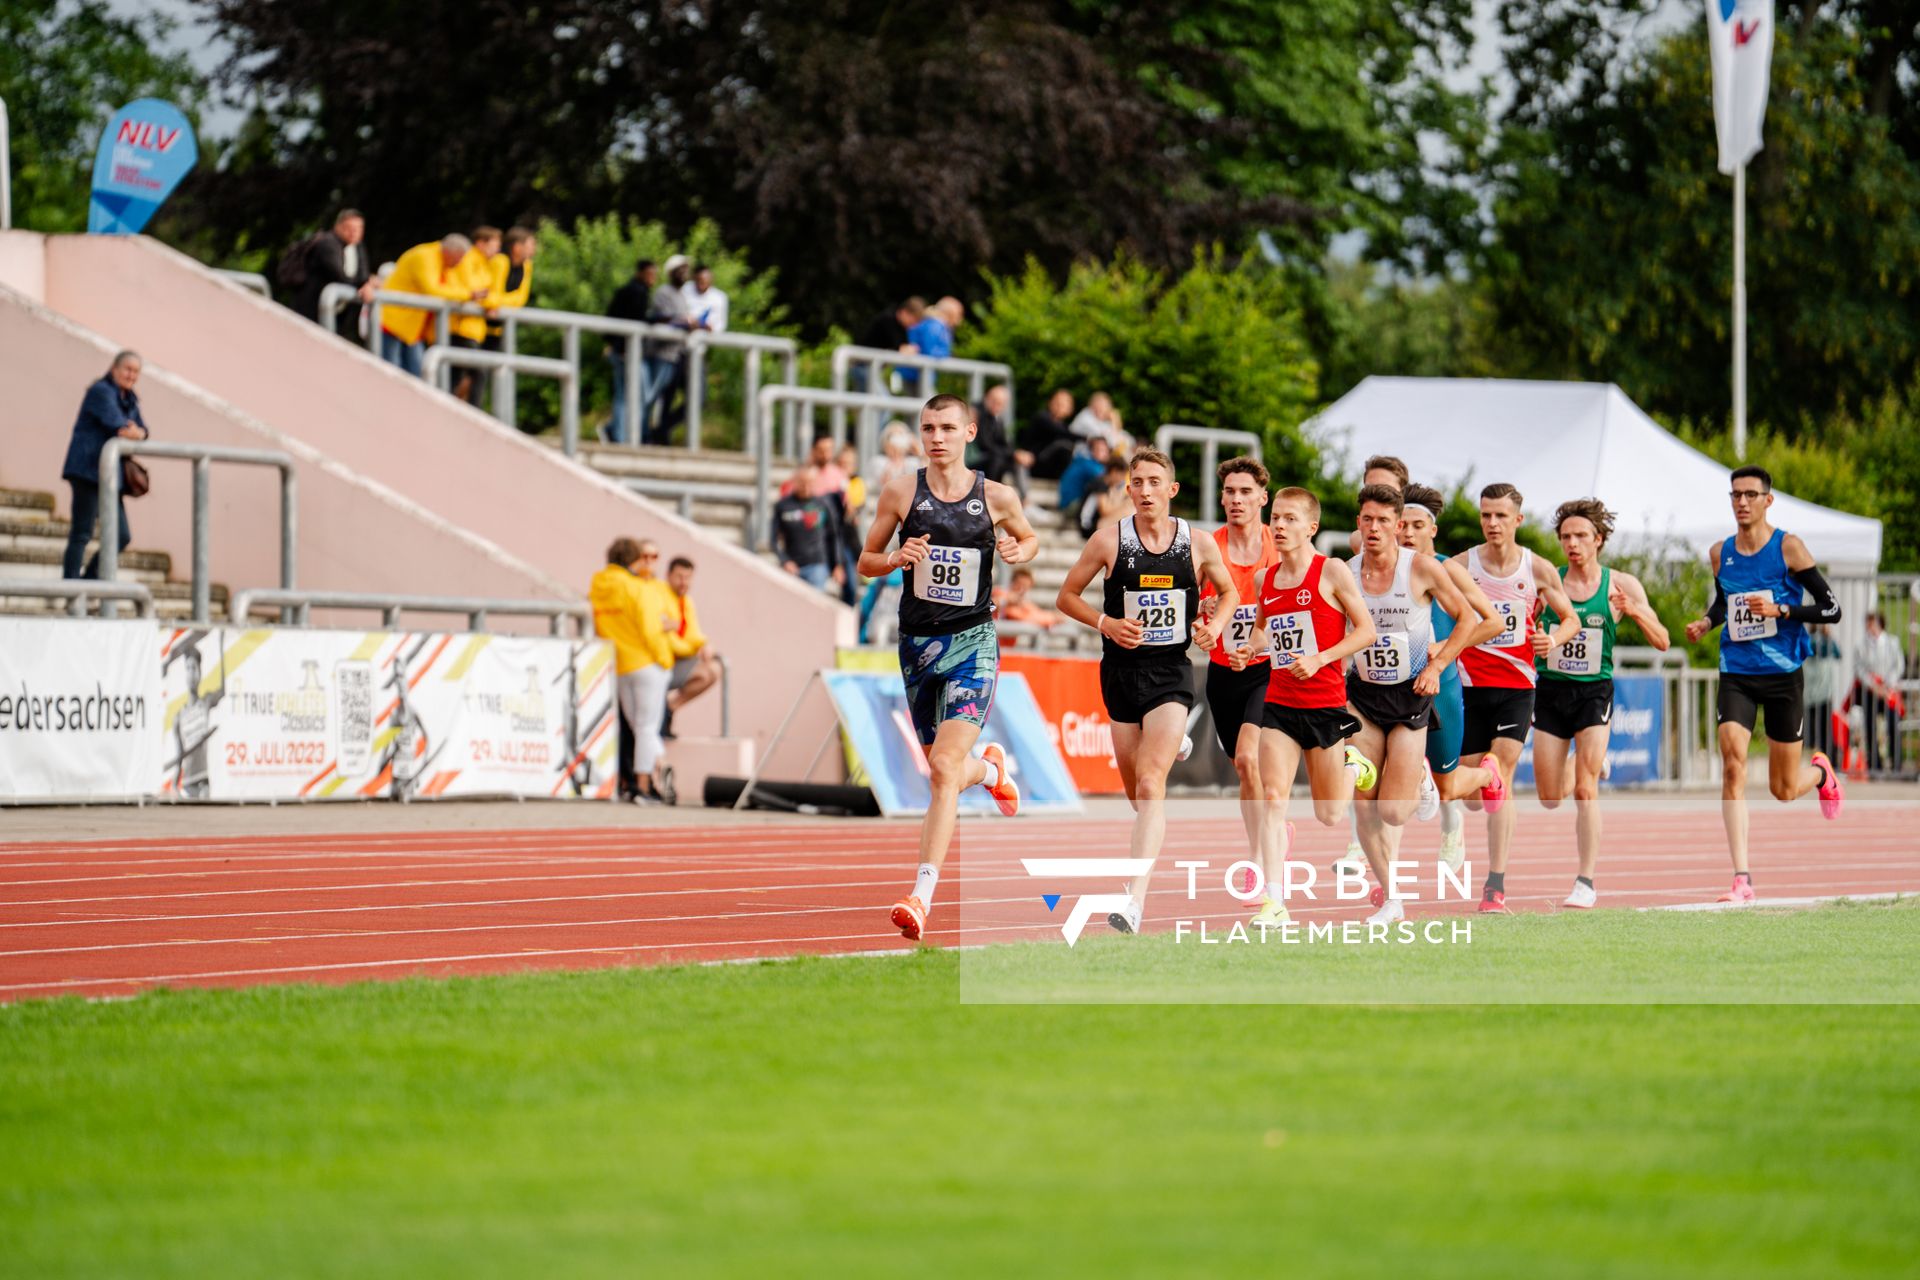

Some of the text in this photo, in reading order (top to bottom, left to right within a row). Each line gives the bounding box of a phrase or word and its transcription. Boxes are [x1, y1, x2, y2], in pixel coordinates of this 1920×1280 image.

[117, 118, 180, 153] NLV
[931, 564, 961, 587] 98
[941, 588, 962, 598] PLAN
[1136, 607, 1176, 628] 428
[1379, 607, 1410, 615] FINANZ
[1154, 630, 1173, 638] PLAN
[1231, 621, 1256, 641] 27
[1272, 629, 1304, 652] 367
[1362, 648, 1400, 668] 153
[1562, 641, 1586, 659] 88
[1378, 671, 1397, 679] PLAN
